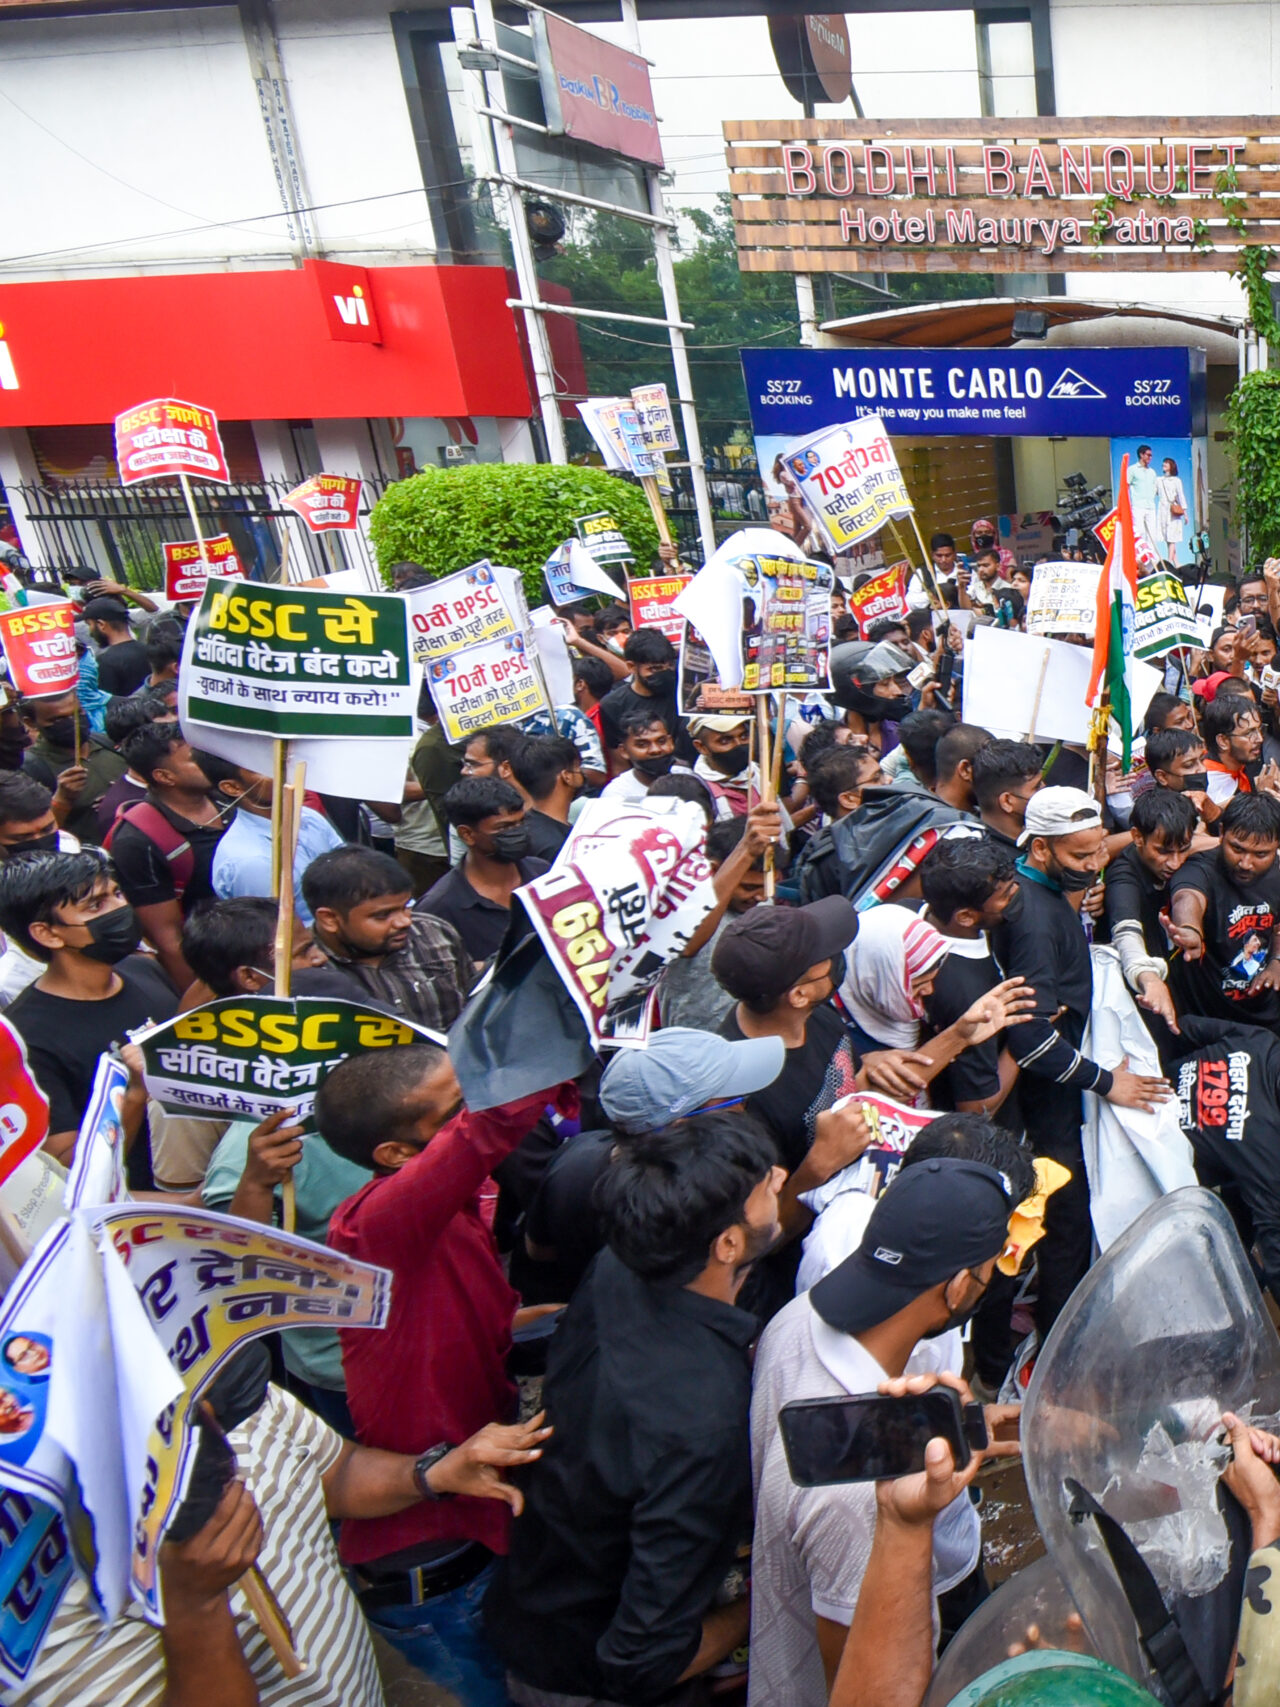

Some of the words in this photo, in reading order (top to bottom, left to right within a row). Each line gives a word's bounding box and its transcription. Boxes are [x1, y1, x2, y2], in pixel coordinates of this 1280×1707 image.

[783, 144, 959, 196] BODHI
[983, 143, 1247, 201] BANQUET
[840, 207, 936, 243] Hotel
[946, 207, 1082, 255] Maurya
[333, 284, 370, 326] vi
[766, 380, 802, 393] SS'27
[832, 367, 935, 399] MONTE
[947, 367, 1043, 399] CARLO
[1133, 379, 1172, 394] SS'27
[760, 394, 813, 406] BOOKING
[875, 406, 896, 418] the
[897, 407, 921, 420] way
[922, 408, 944, 421] you
[946, 406, 980, 418] make
[981, 408, 1002, 419] me
[1003, 405, 1027, 419] feel
[1125, 395, 1181, 406] BOOKING
[121, 406, 161, 433] BSSC
[162, 405, 203, 427] जागो
[131, 426, 186, 449] परीक्षा
[186, 427, 209, 450] की
[452, 585, 499, 620] BPSC
[8, 609, 70, 637] BSSC
[209, 593, 307, 642] BSSC
[317, 597, 378, 645] से
[451, 625, 466, 643] को
[465, 615, 486, 640] पूरी
[197, 633, 245, 668] संविदा
[246, 640, 298, 675] वेटेज
[300, 647, 341, 677] बंद
[344, 650, 399, 679] करो
[444, 664, 488, 698] 70वीं
[491, 653, 529, 683] BPSC
[236, 680, 250, 698] के
[252, 686, 287, 704] साथ
[291, 689, 339, 705] न्याय
[449, 693, 485, 716] परीक्षा
[484, 688, 500, 704] को
[458, 709, 494, 732] निरस्त
[494, 701, 522, 717] किया
[1256, 901, 1271, 915] को
[1260, 912, 1274, 928] दो
[173, 1008, 341, 1054] BSSC
[156, 1043, 248, 1083] संविदा
[251, 1054, 321, 1090] वेटेज
[1227, 1051, 1251, 1094] बिहार
[233, 1096, 252, 1114] के
[1202, 1060, 1229, 1127] 1799
[1225, 1094, 1251, 1140] दरोगा
